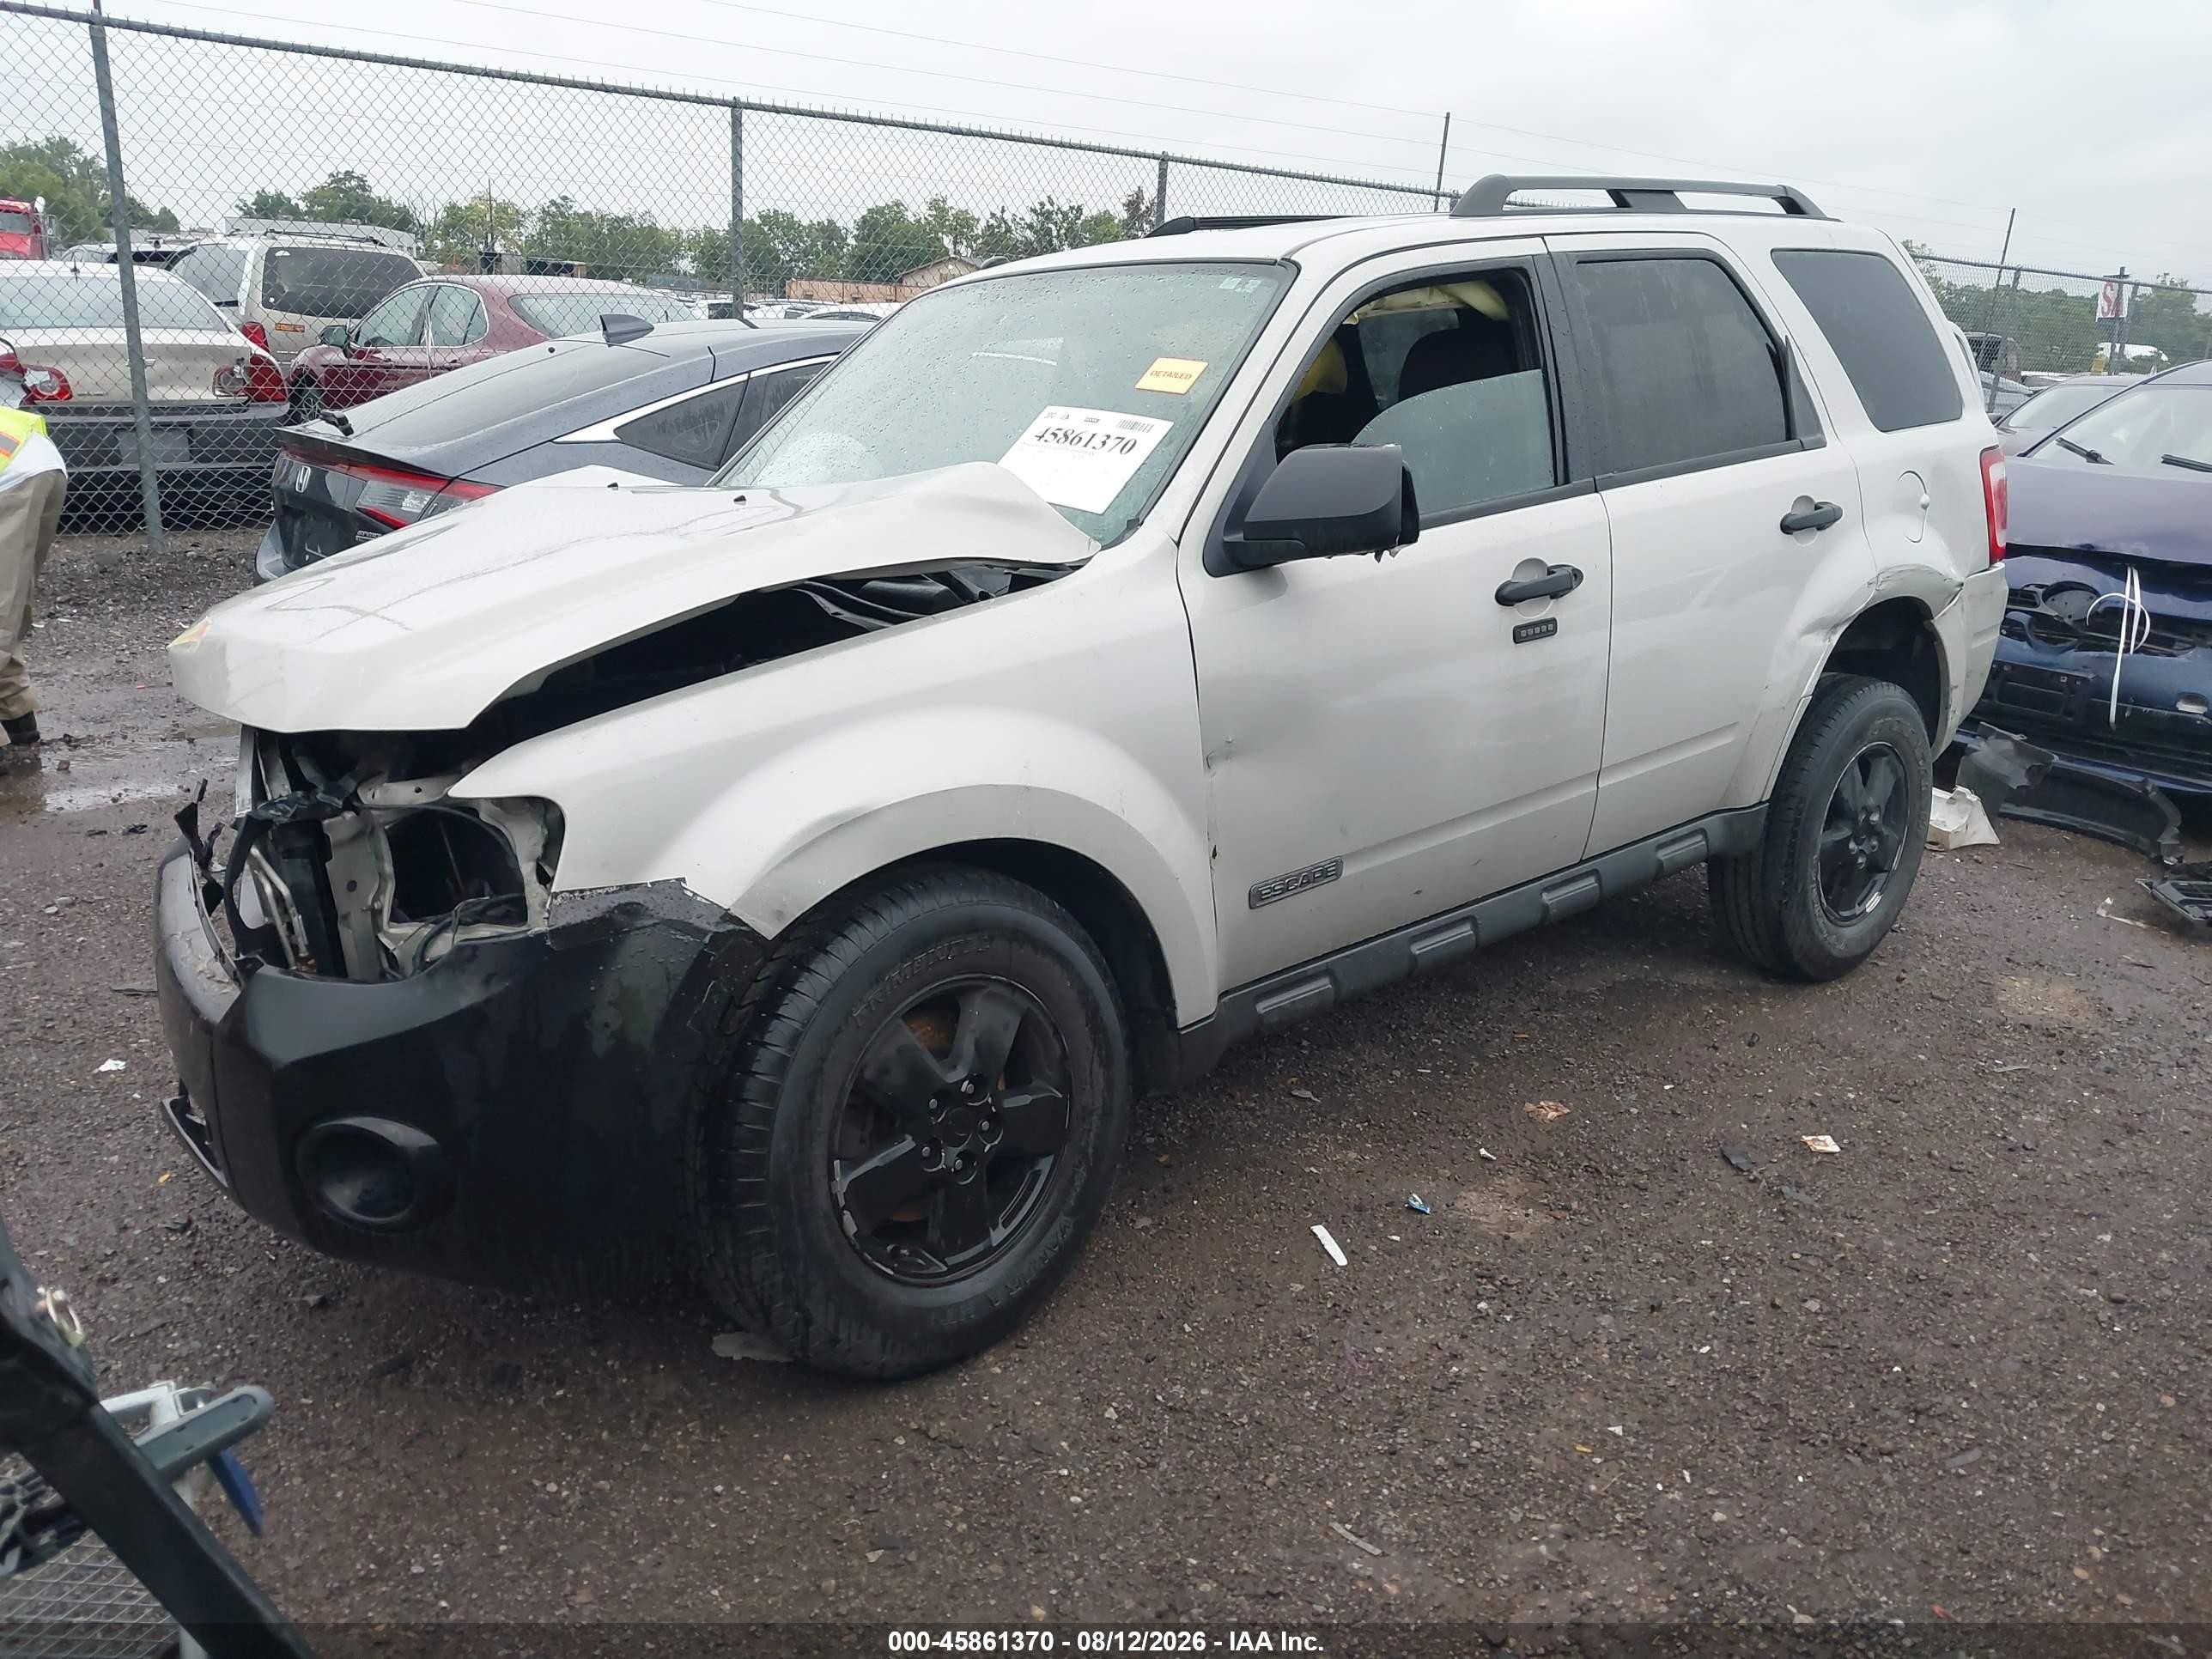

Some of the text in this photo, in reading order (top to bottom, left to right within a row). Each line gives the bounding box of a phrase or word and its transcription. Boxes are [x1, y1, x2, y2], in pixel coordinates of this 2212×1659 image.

[1150, 370, 1193, 380] DETAILED
[1035, 427, 1138, 455] 45861370
[1257, 861, 1337, 900] ESCAPE
